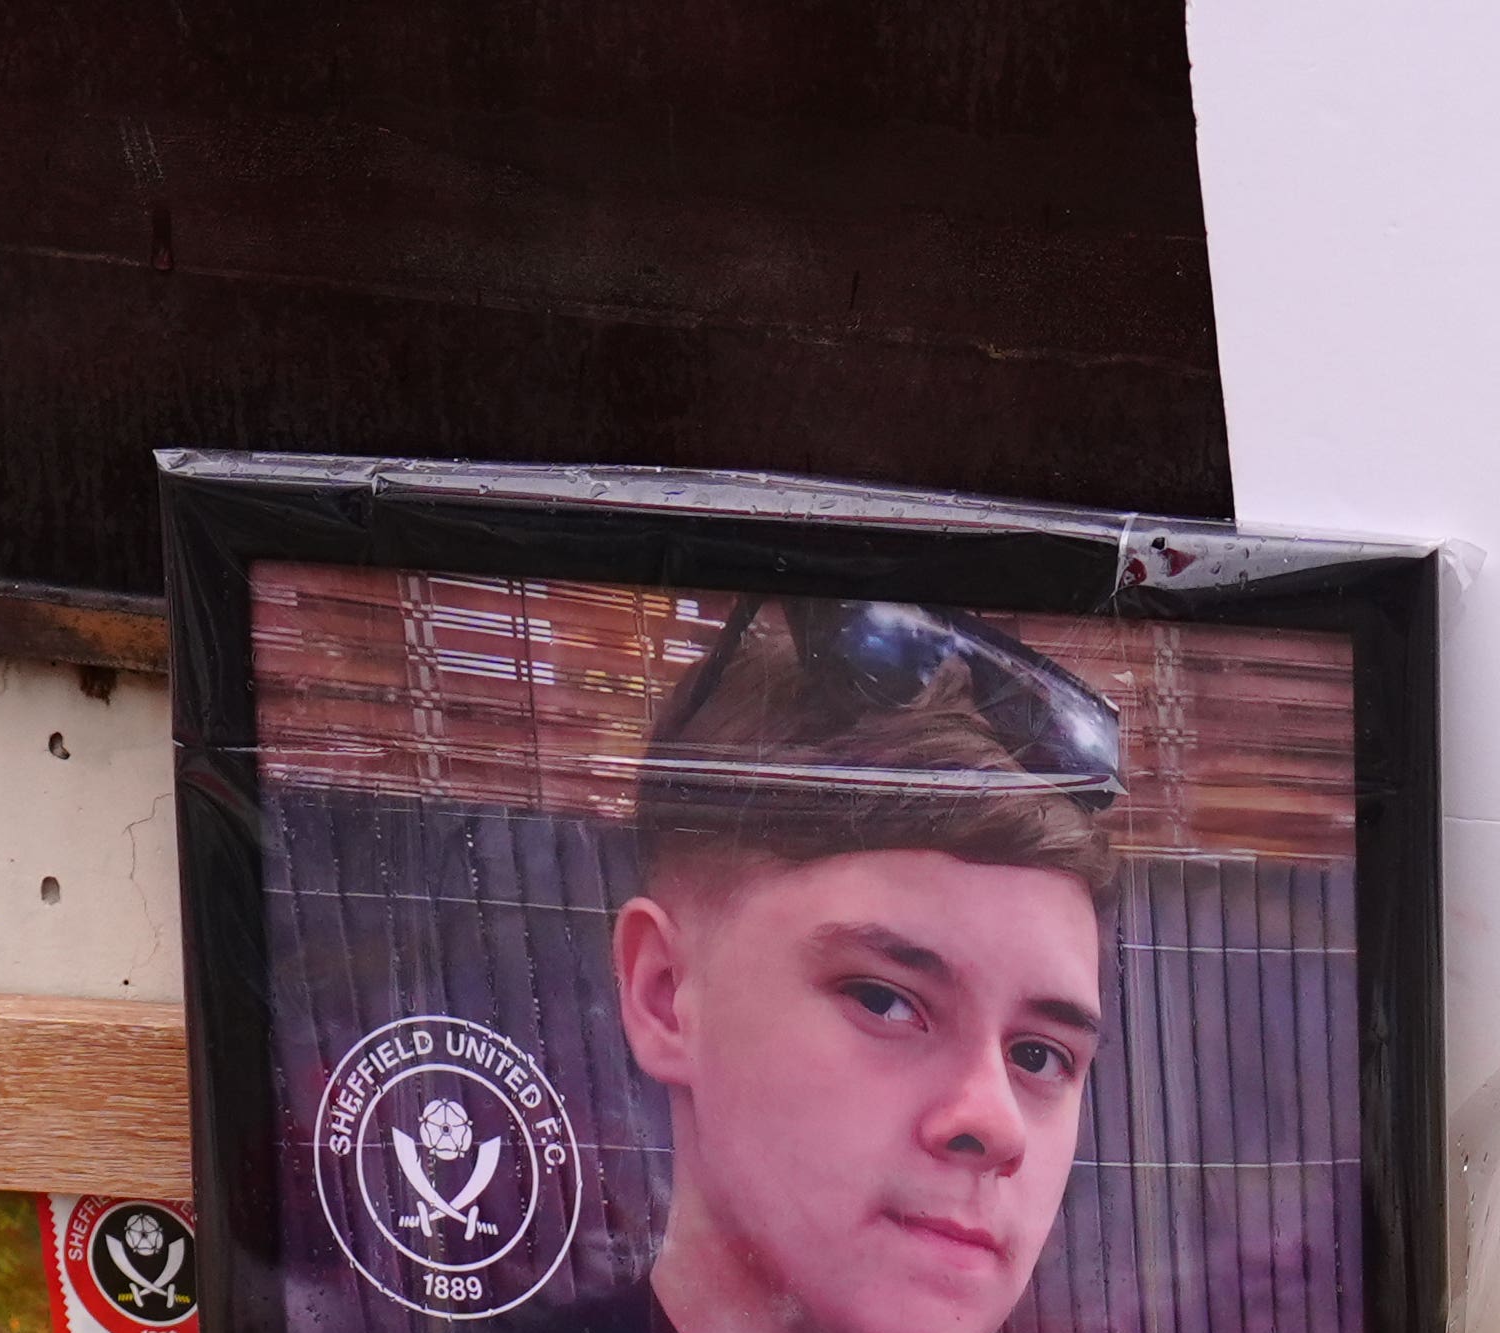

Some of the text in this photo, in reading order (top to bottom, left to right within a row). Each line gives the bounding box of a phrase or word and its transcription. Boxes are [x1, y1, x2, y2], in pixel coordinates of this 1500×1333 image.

[329, 1030, 566, 1175] SHEFFIELD UNITED F.C.
[68, 1194, 115, 1261] SHEFFI
[423, 1273, 483, 1301] 1889
